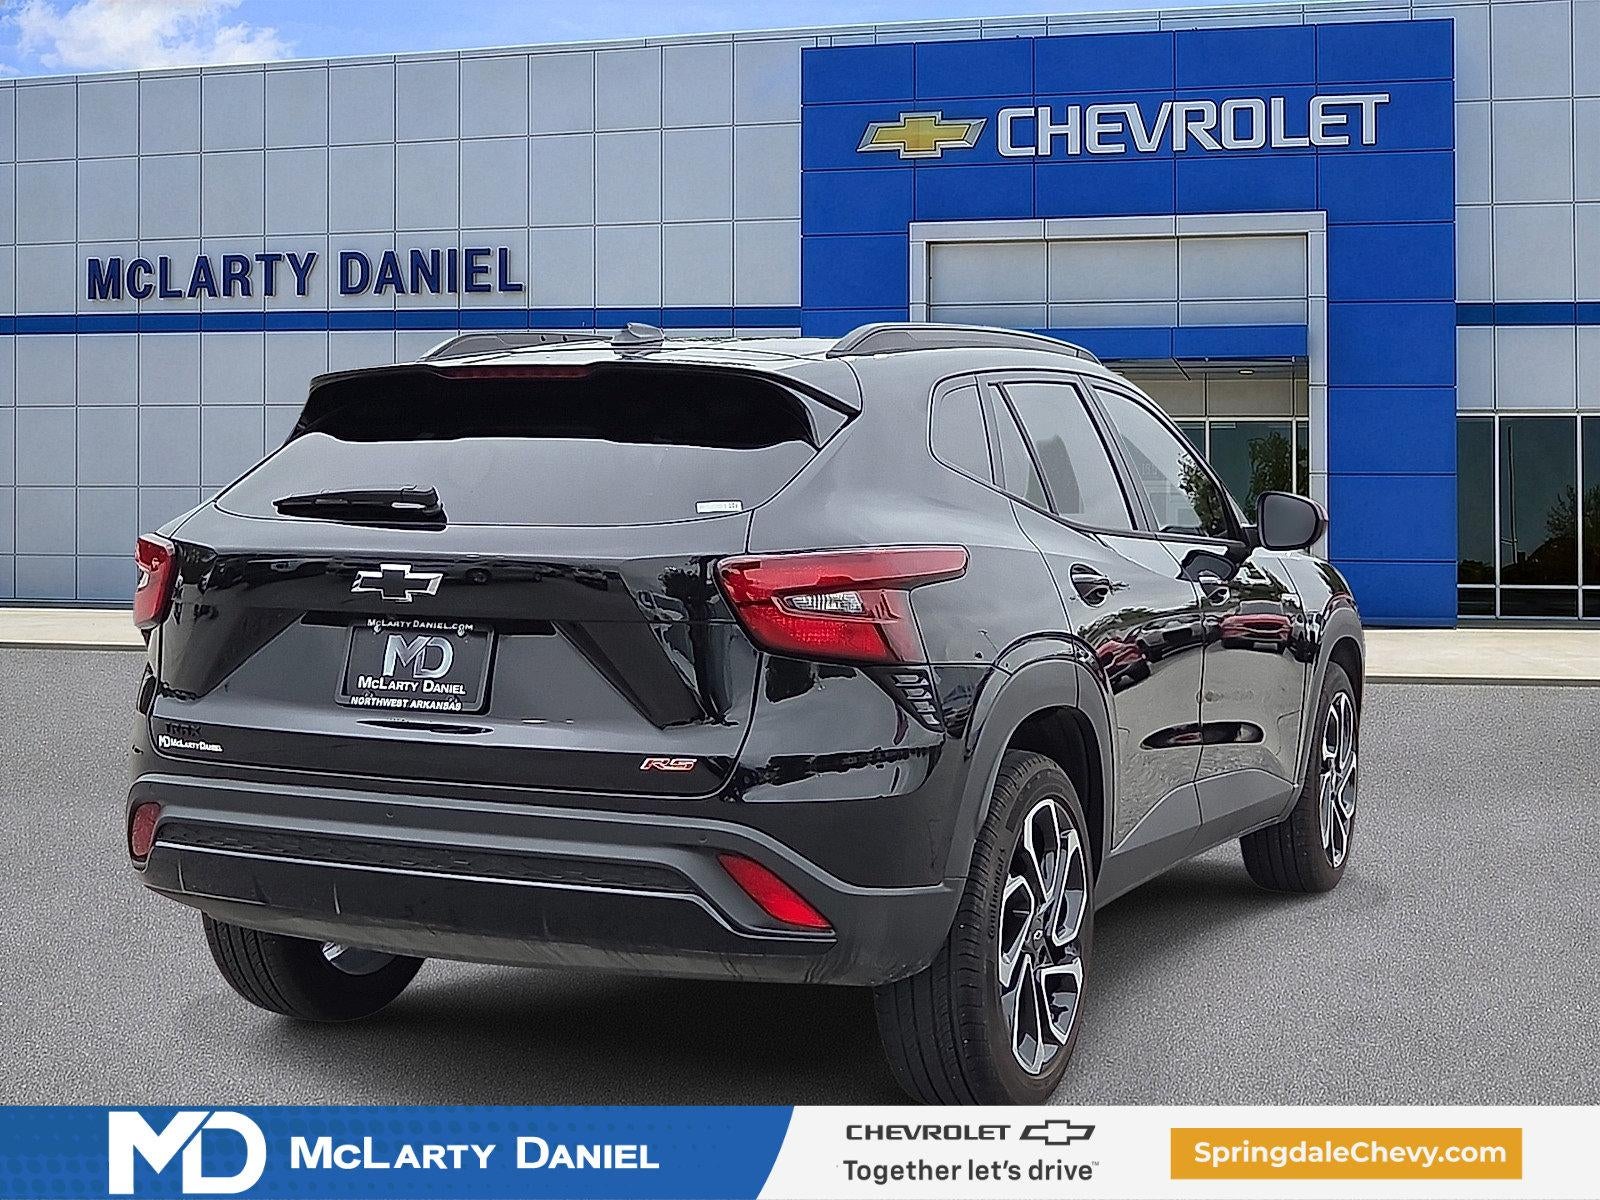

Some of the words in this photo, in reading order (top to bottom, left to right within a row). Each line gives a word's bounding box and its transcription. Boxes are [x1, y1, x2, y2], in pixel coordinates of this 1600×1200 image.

[997, 93, 1390, 157] CHEVROLET
[339, 246, 525, 296] DANIEL
[350, 696, 409, 709] NORTHWEST
[410, 699, 461, 711] ARKANSAS
[639, 757, 698, 771] RS
